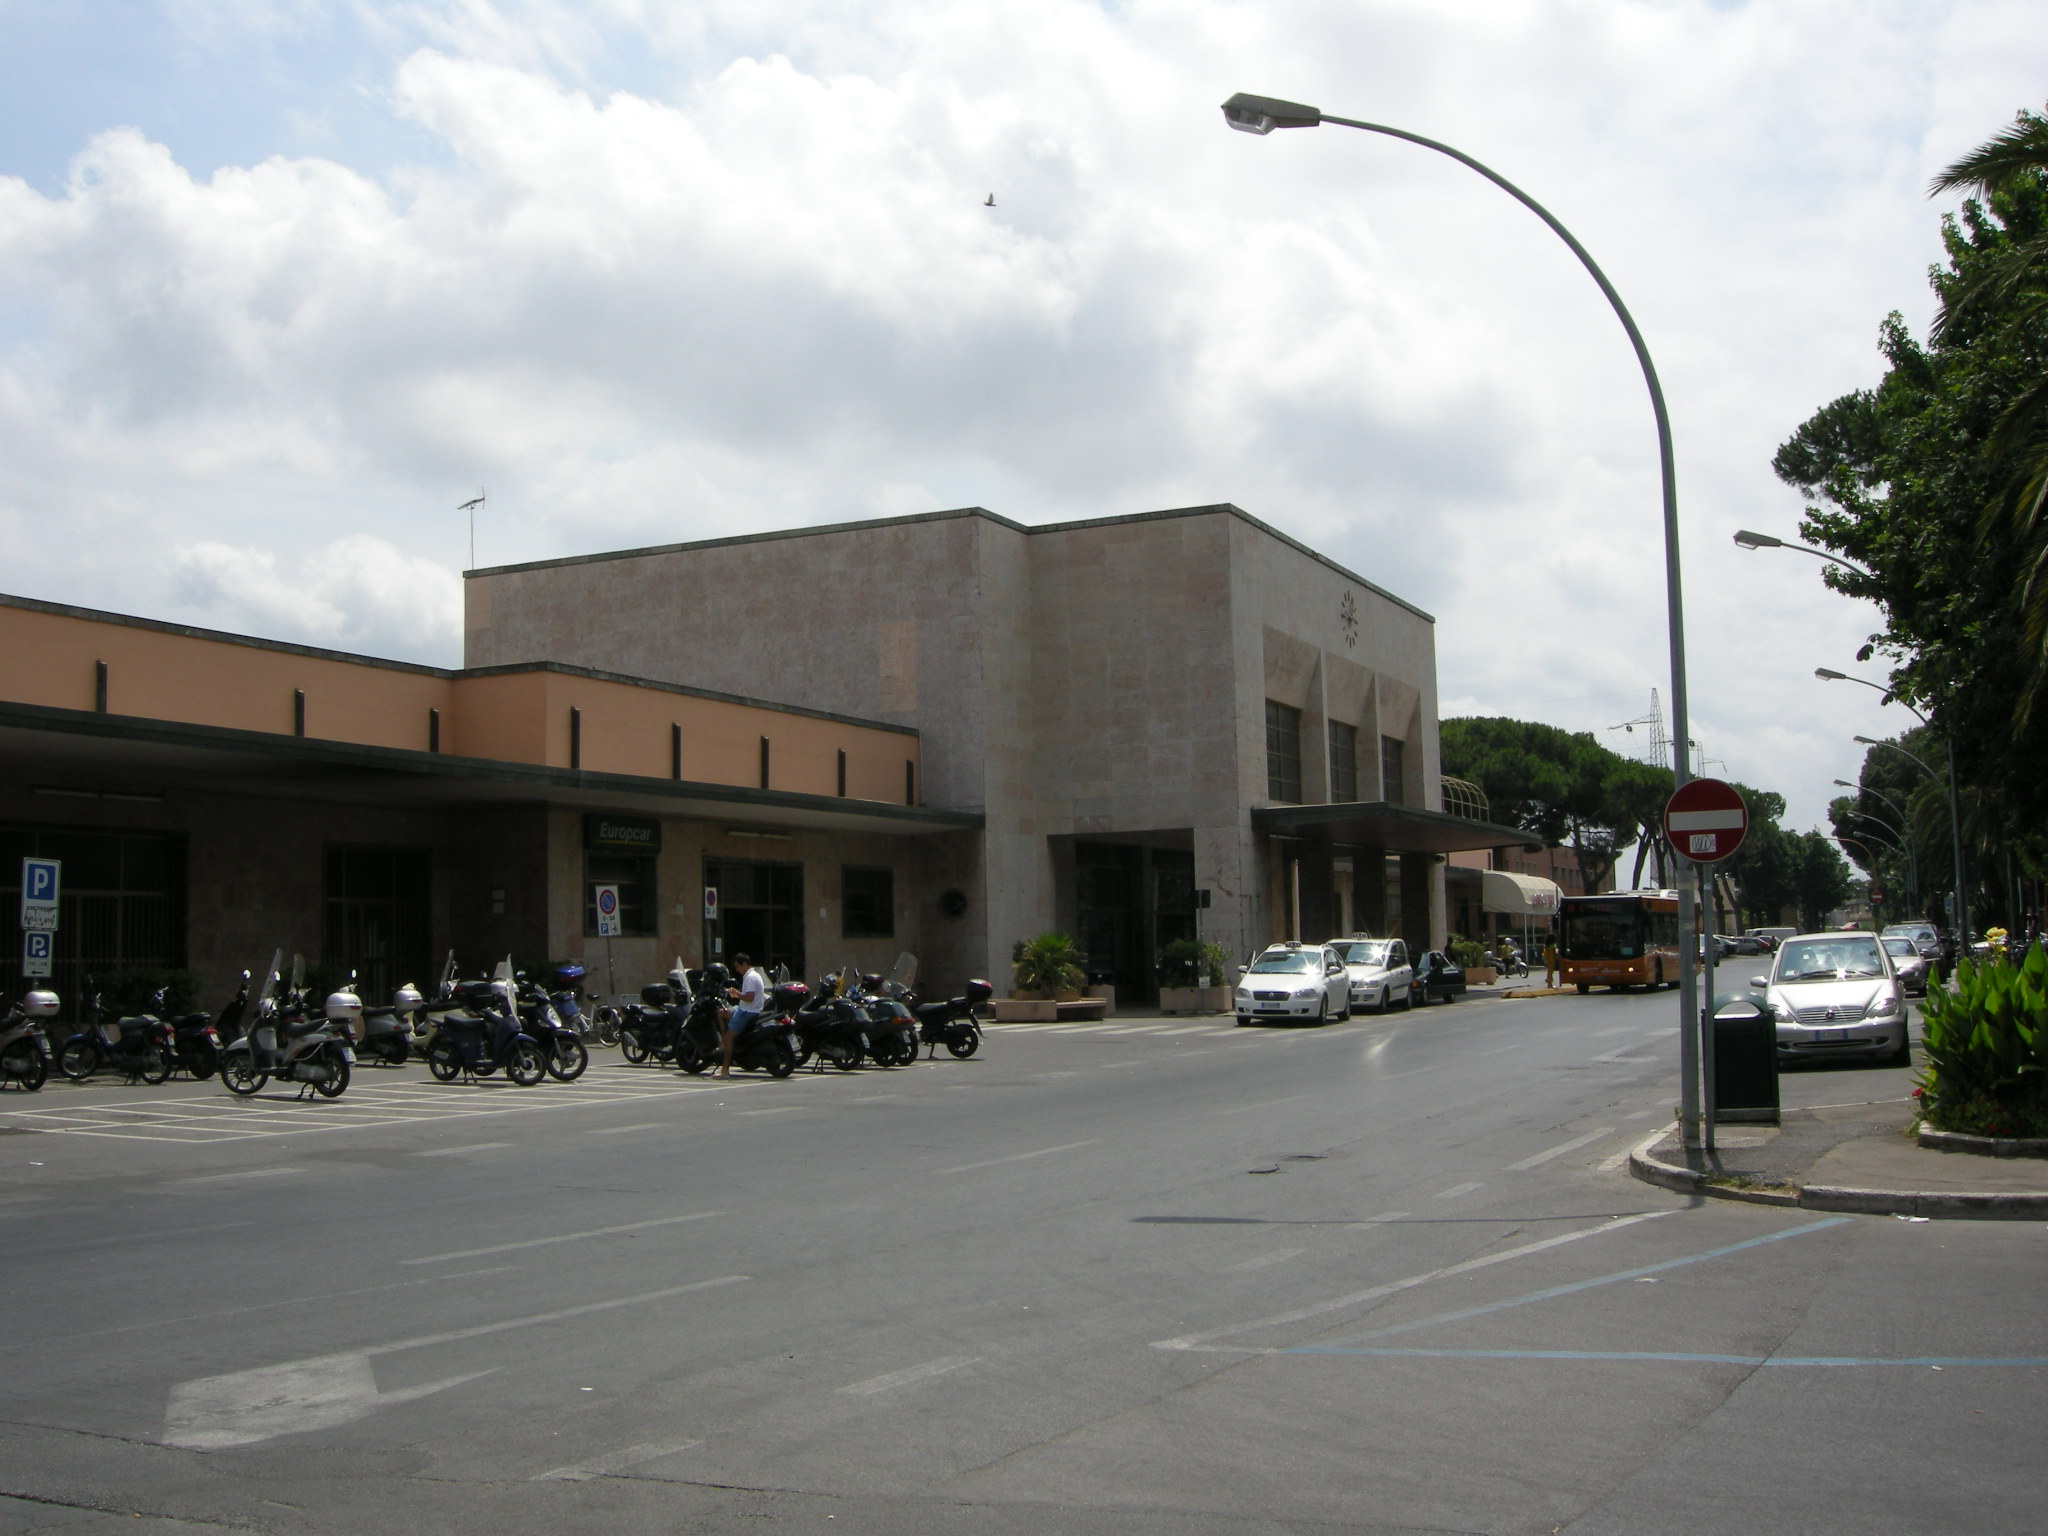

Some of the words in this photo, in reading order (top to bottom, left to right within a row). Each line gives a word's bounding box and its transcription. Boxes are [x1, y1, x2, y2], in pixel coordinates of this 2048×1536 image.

[600, 821, 652, 844] Europcar
[34, 868, 49, 896] P
[32, 936, 45, 955] P
